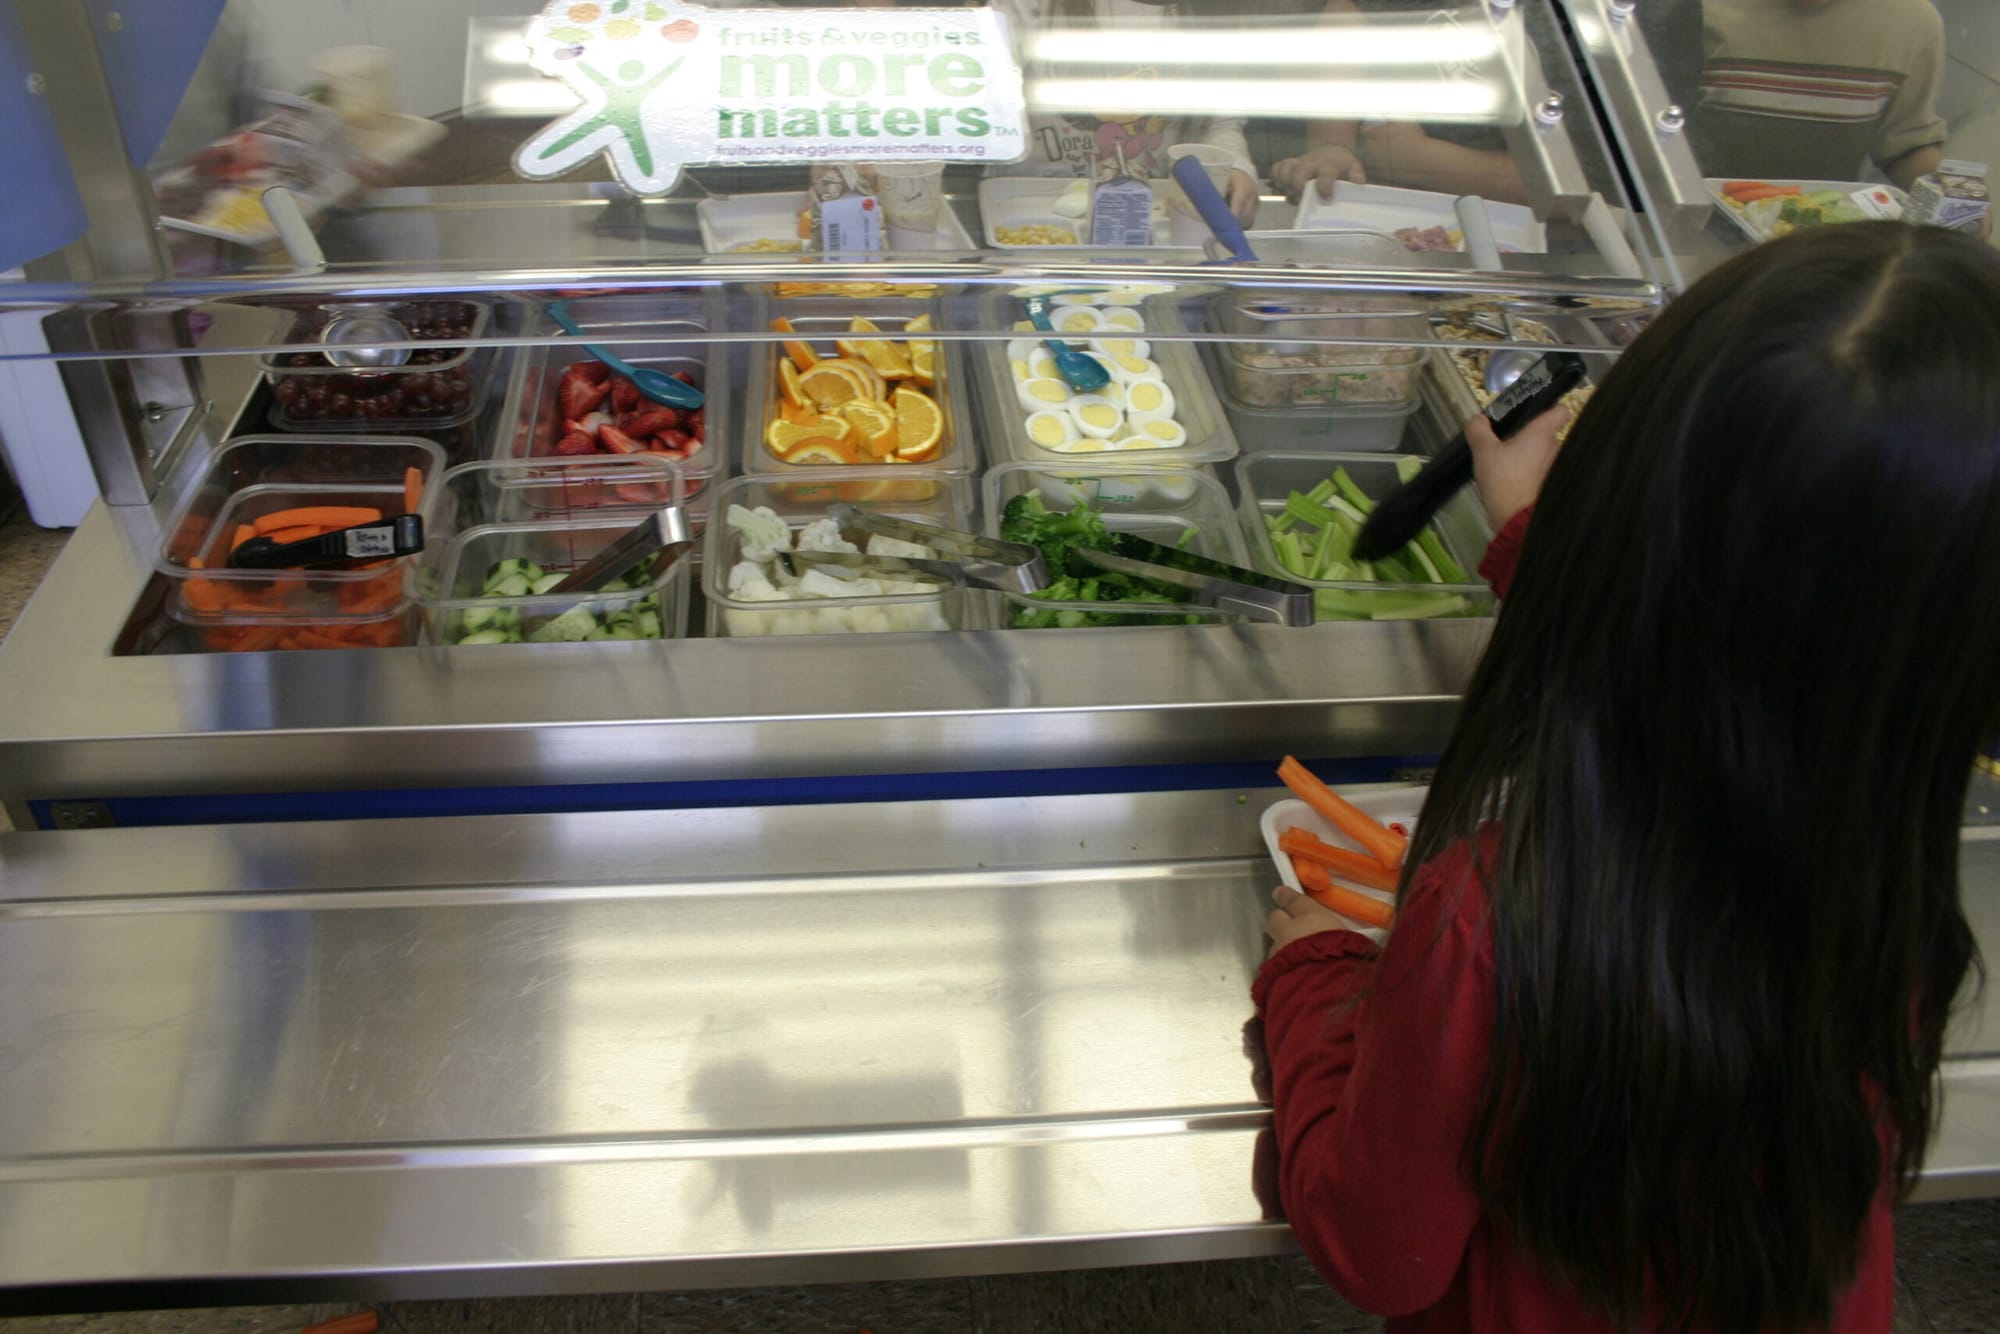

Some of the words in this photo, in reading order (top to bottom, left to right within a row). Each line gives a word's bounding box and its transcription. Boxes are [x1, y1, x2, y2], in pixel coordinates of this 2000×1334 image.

[718, 26, 812, 46] fruits
[851, 26, 982, 48] veggies
[719, 52, 985, 98] more
[717, 100, 991, 139] matters
[716, 143, 986, 157] fruitsandveggiesmorematters.org
[1034, 125, 1093, 162] Dora
